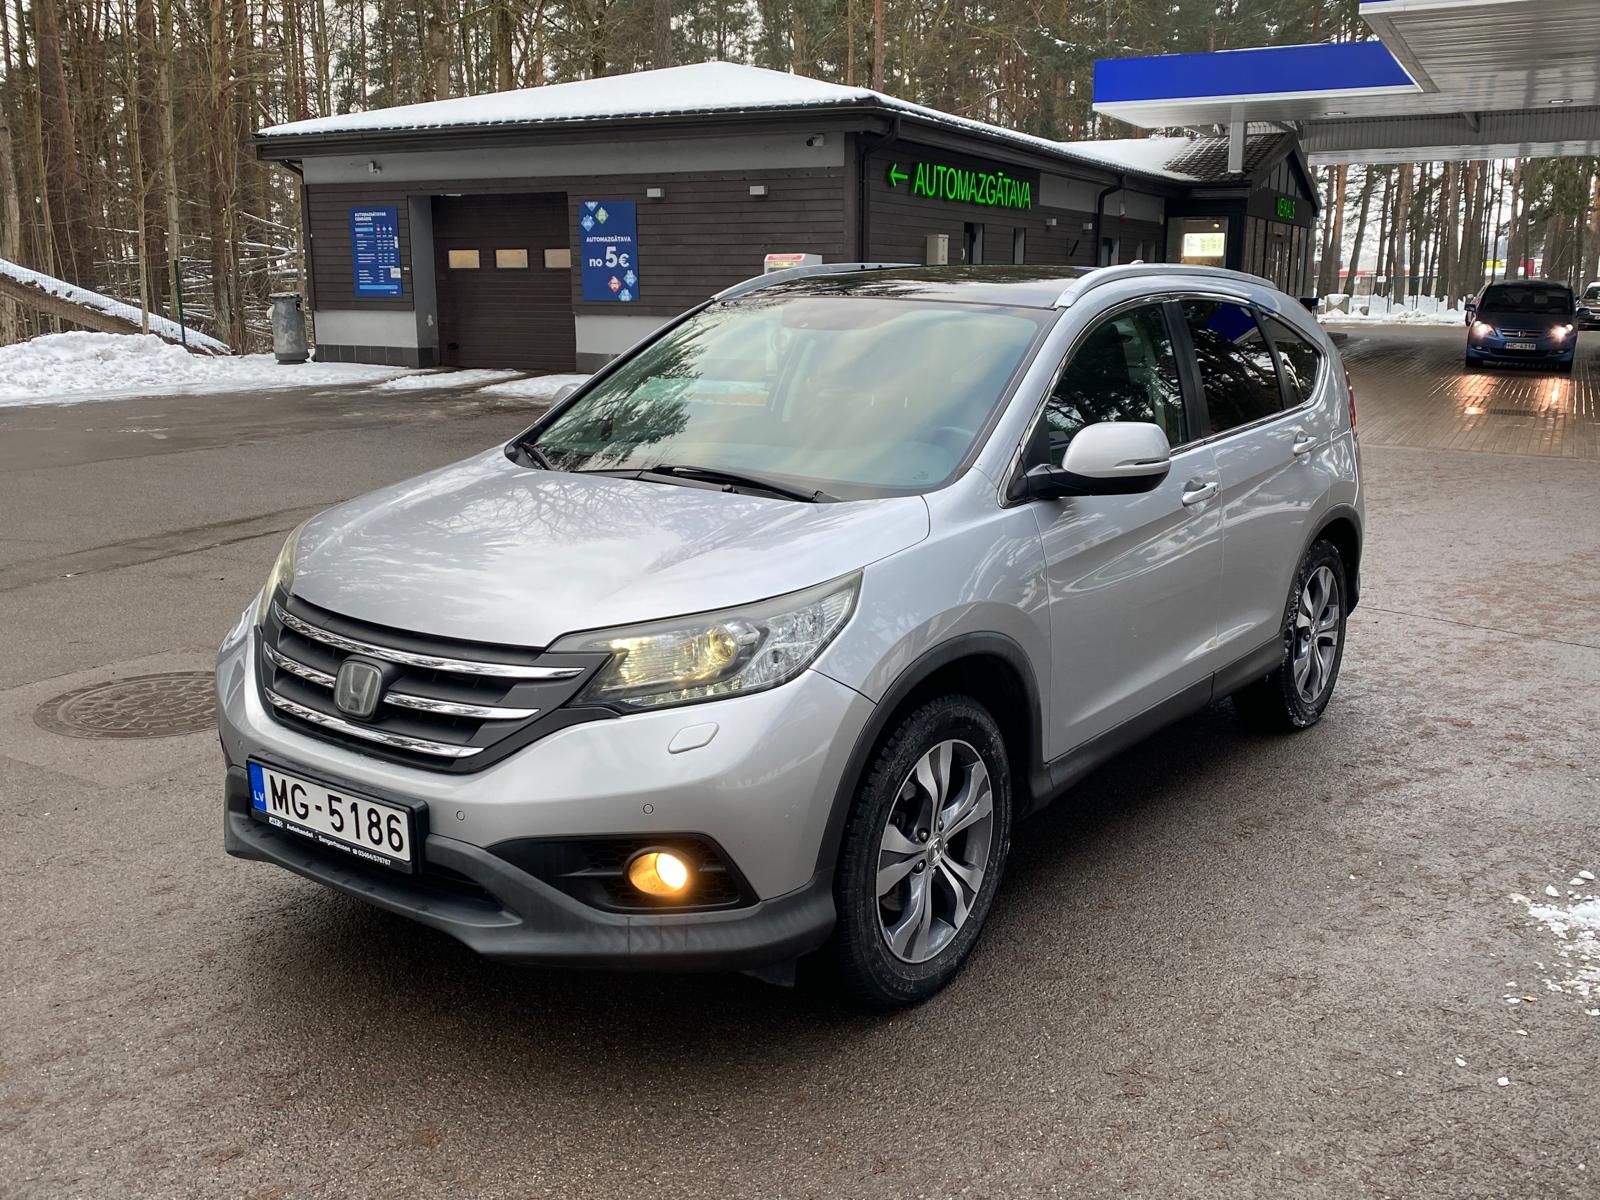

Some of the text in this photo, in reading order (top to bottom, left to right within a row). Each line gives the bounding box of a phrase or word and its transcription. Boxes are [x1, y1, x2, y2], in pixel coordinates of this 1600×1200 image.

[914, 162, 1032, 210] AUTOMAZGĀTAVA
[586, 235, 631, 243] AUTOMAZGĀTAVA
[589, 258, 603, 267] no
[253, 790, 265, 802] LV
[269, 775, 404, 853] MG-5186
[286, 823, 314, 840] Autohandel
